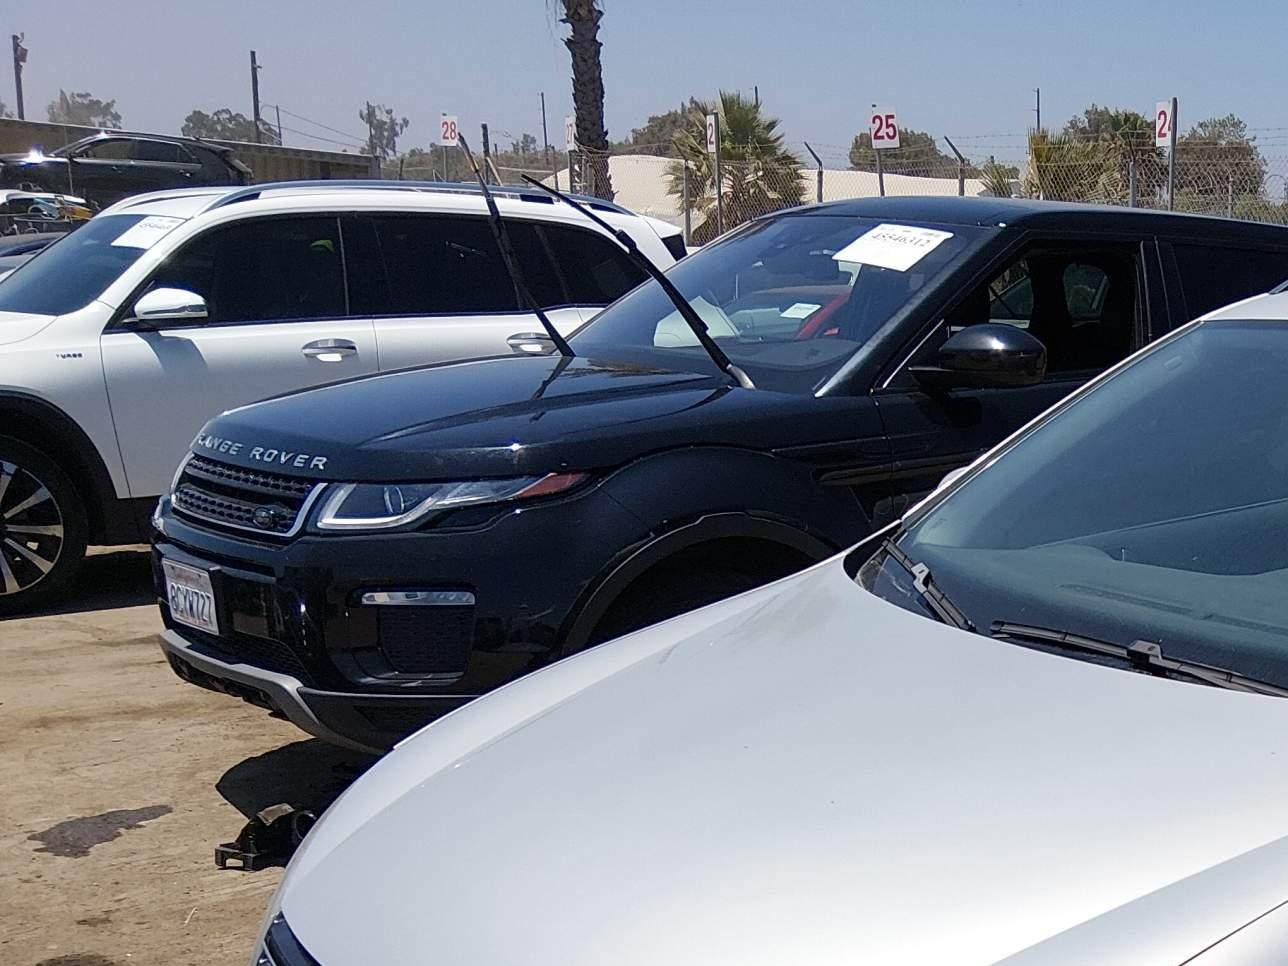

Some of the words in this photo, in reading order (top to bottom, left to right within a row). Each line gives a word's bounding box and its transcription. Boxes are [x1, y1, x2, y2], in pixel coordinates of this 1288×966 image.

[442, 121, 457, 140] 28
[707, 122, 715, 146] 2
[872, 114, 898, 141] 25
[249, 446, 328, 470] ROVER
